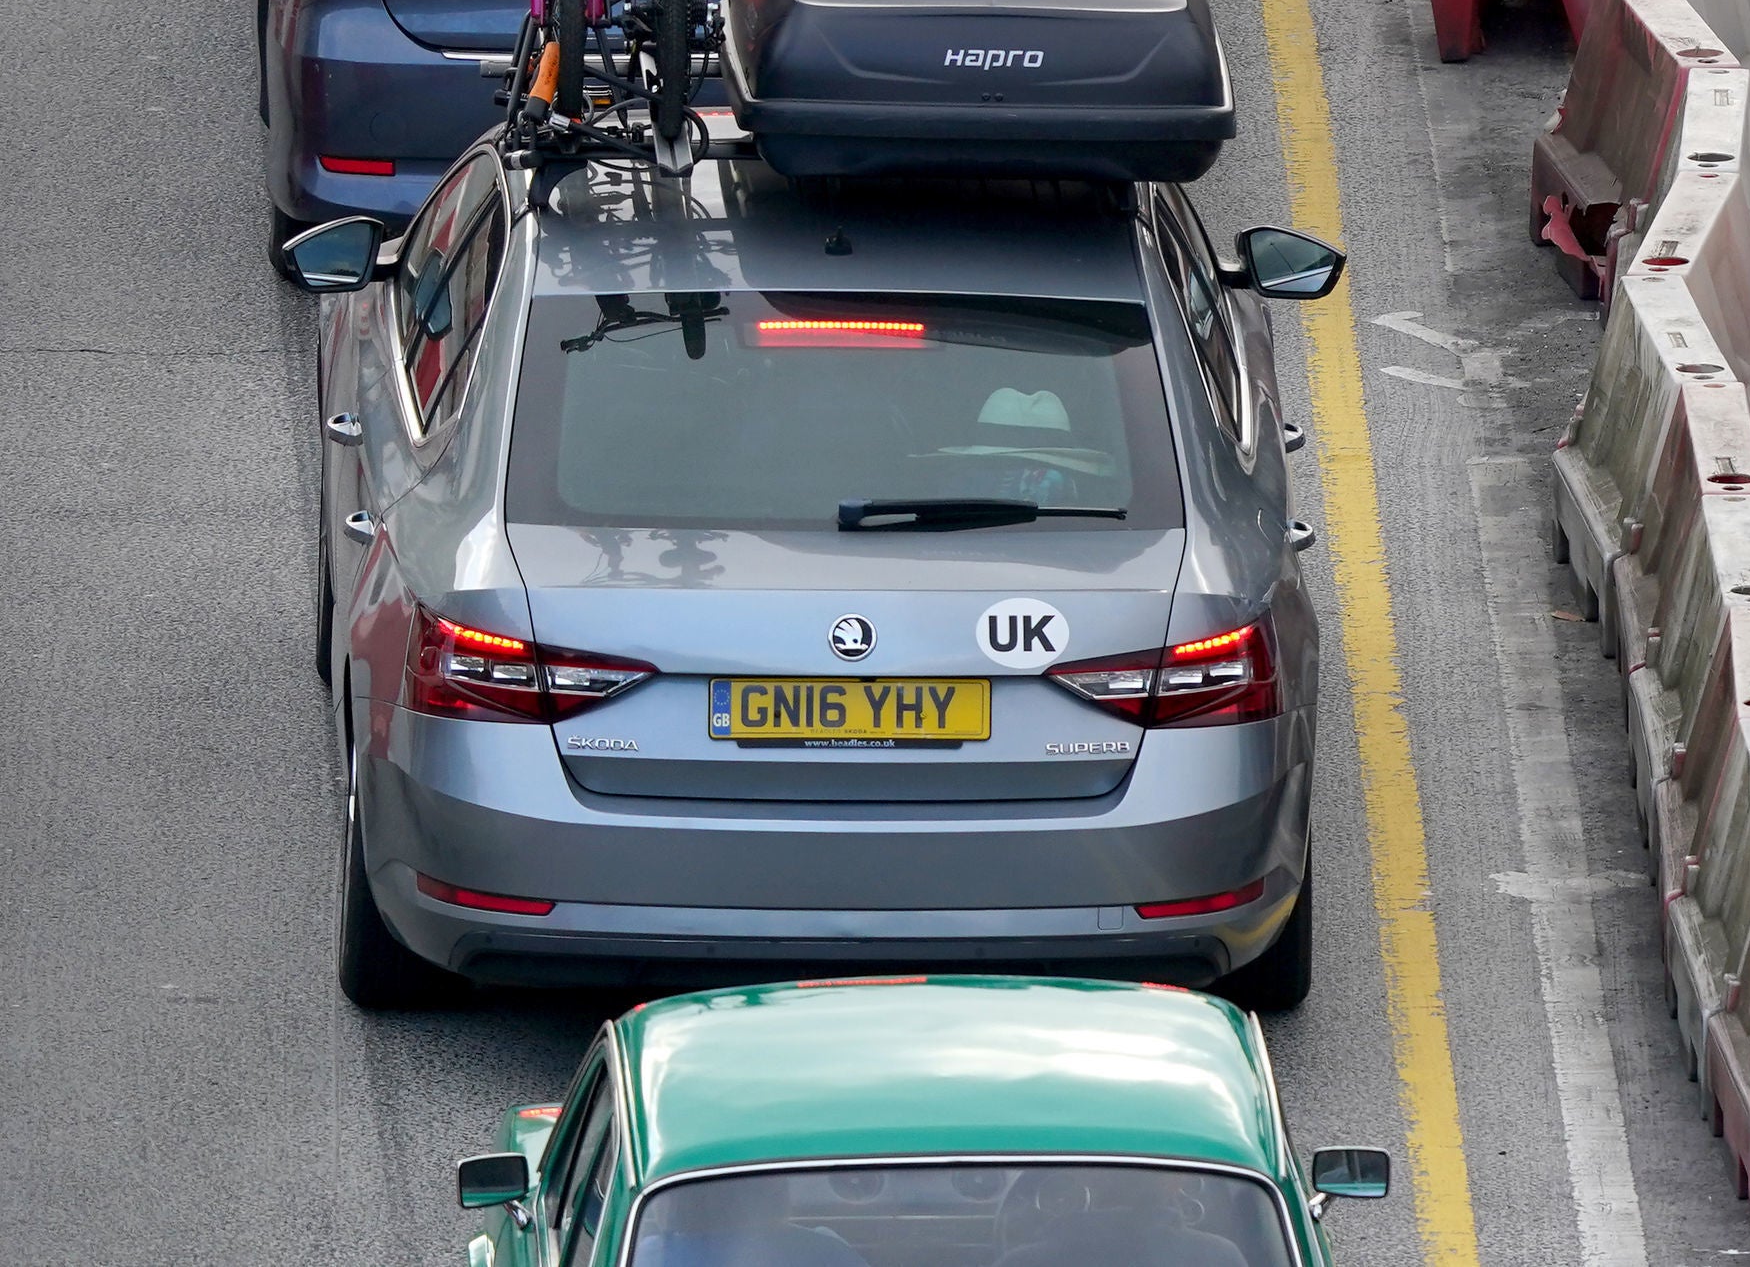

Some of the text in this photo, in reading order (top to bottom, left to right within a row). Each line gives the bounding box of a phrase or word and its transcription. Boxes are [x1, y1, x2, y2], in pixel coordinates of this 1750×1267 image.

[988, 615, 1056, 652] UK
[740, 685, 956, 729] GN16 YHY
[713, 713, 730, 727] GB
[804, 738, 896, 747] www.beadles.co.uk
[1046, 741, 1131, 755] SUPERB
